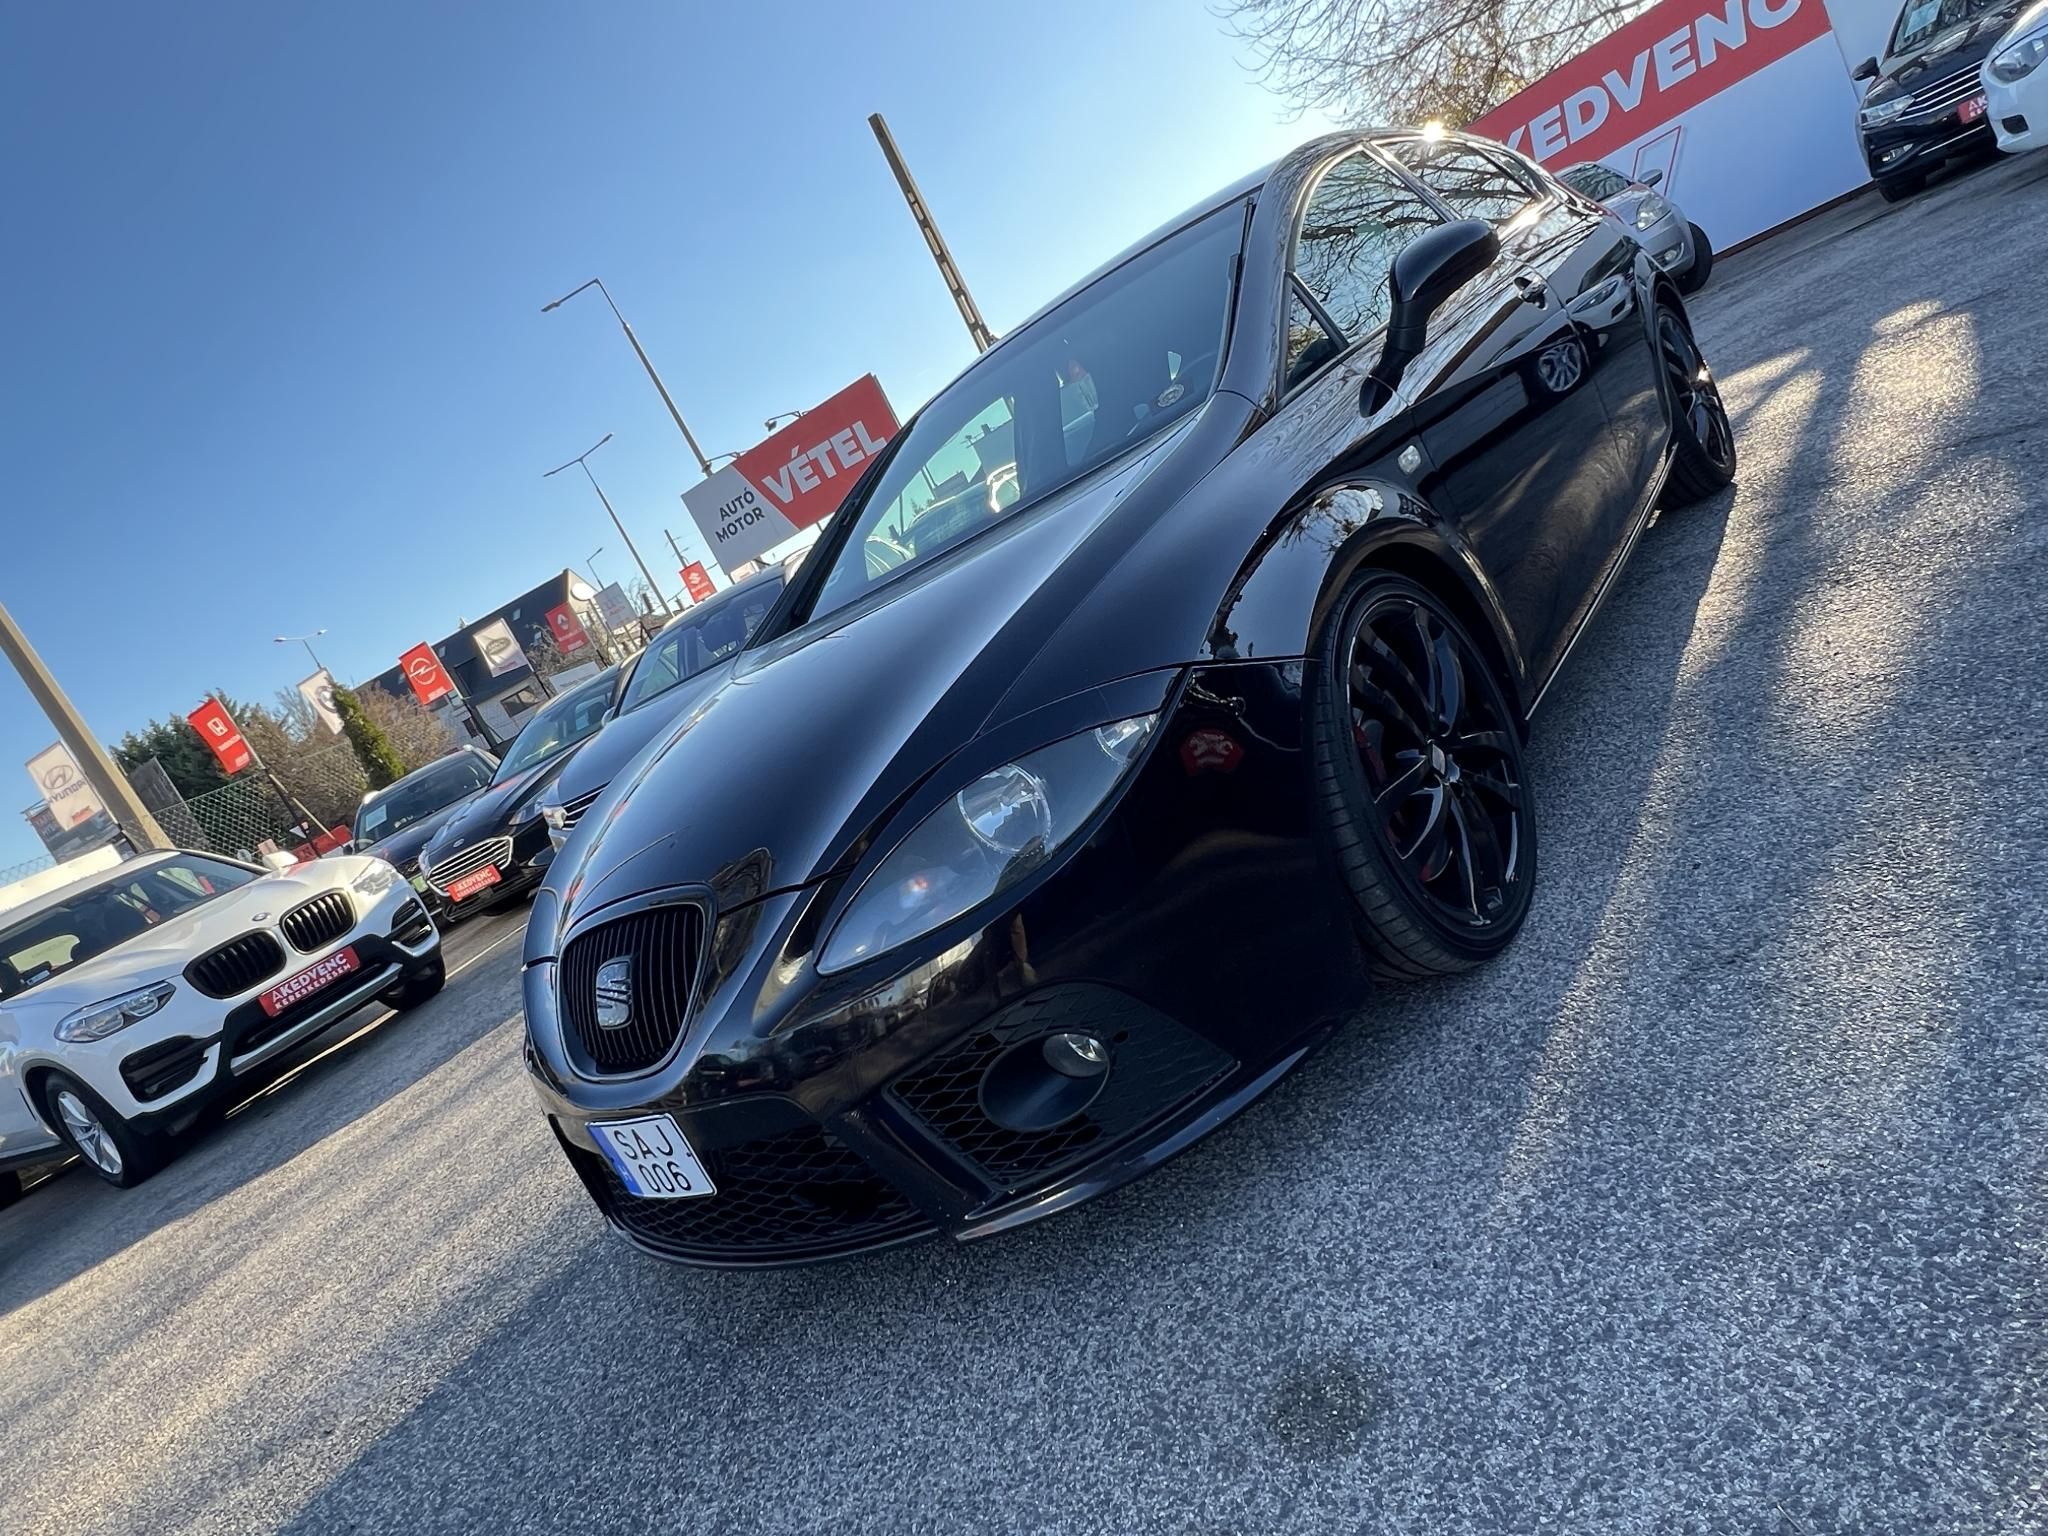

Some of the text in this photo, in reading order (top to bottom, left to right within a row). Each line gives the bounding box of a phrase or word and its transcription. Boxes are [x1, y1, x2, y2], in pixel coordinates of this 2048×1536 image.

[1503, 0, 1800, 163] EDVENC
[761, 421, 887, 504] VÉTEL
[718, 486, 755, 521] AUTÓ
[715, 506, 765, 543] MOTOR
[272, 953, 347, 1003] AKEDVENC
[614, 1125, 674, 1160] SAJ
[638, 1161, 691, 1193] 006
